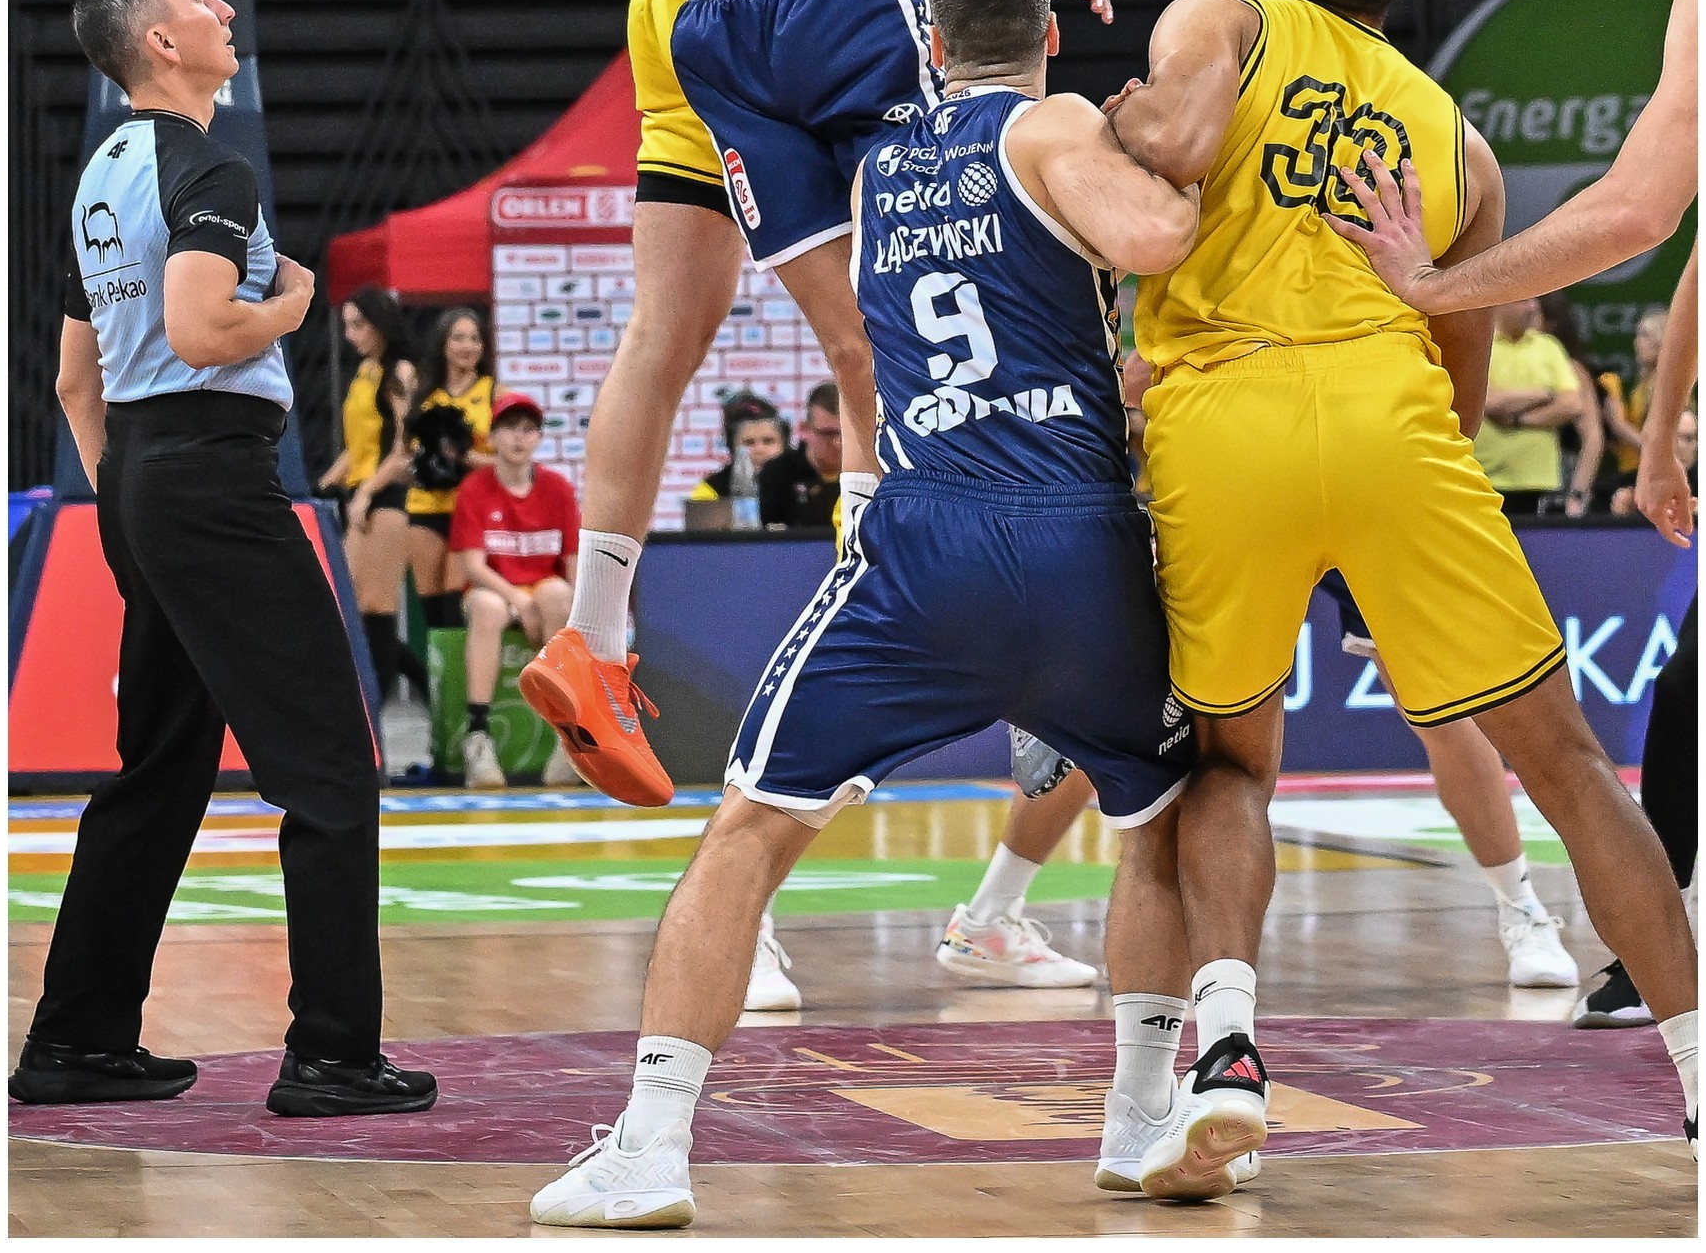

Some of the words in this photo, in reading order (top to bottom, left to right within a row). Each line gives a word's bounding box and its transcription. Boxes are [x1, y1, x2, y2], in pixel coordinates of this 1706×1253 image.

[876, 180, 951, 218] netia
[873, 214, 1004, 274] ŁĄCZYŃSKI
[107, 278, 148, 305] Pekao
[910, 271, 999, 387] 9
[1158, 722, 1191, 756] netia
